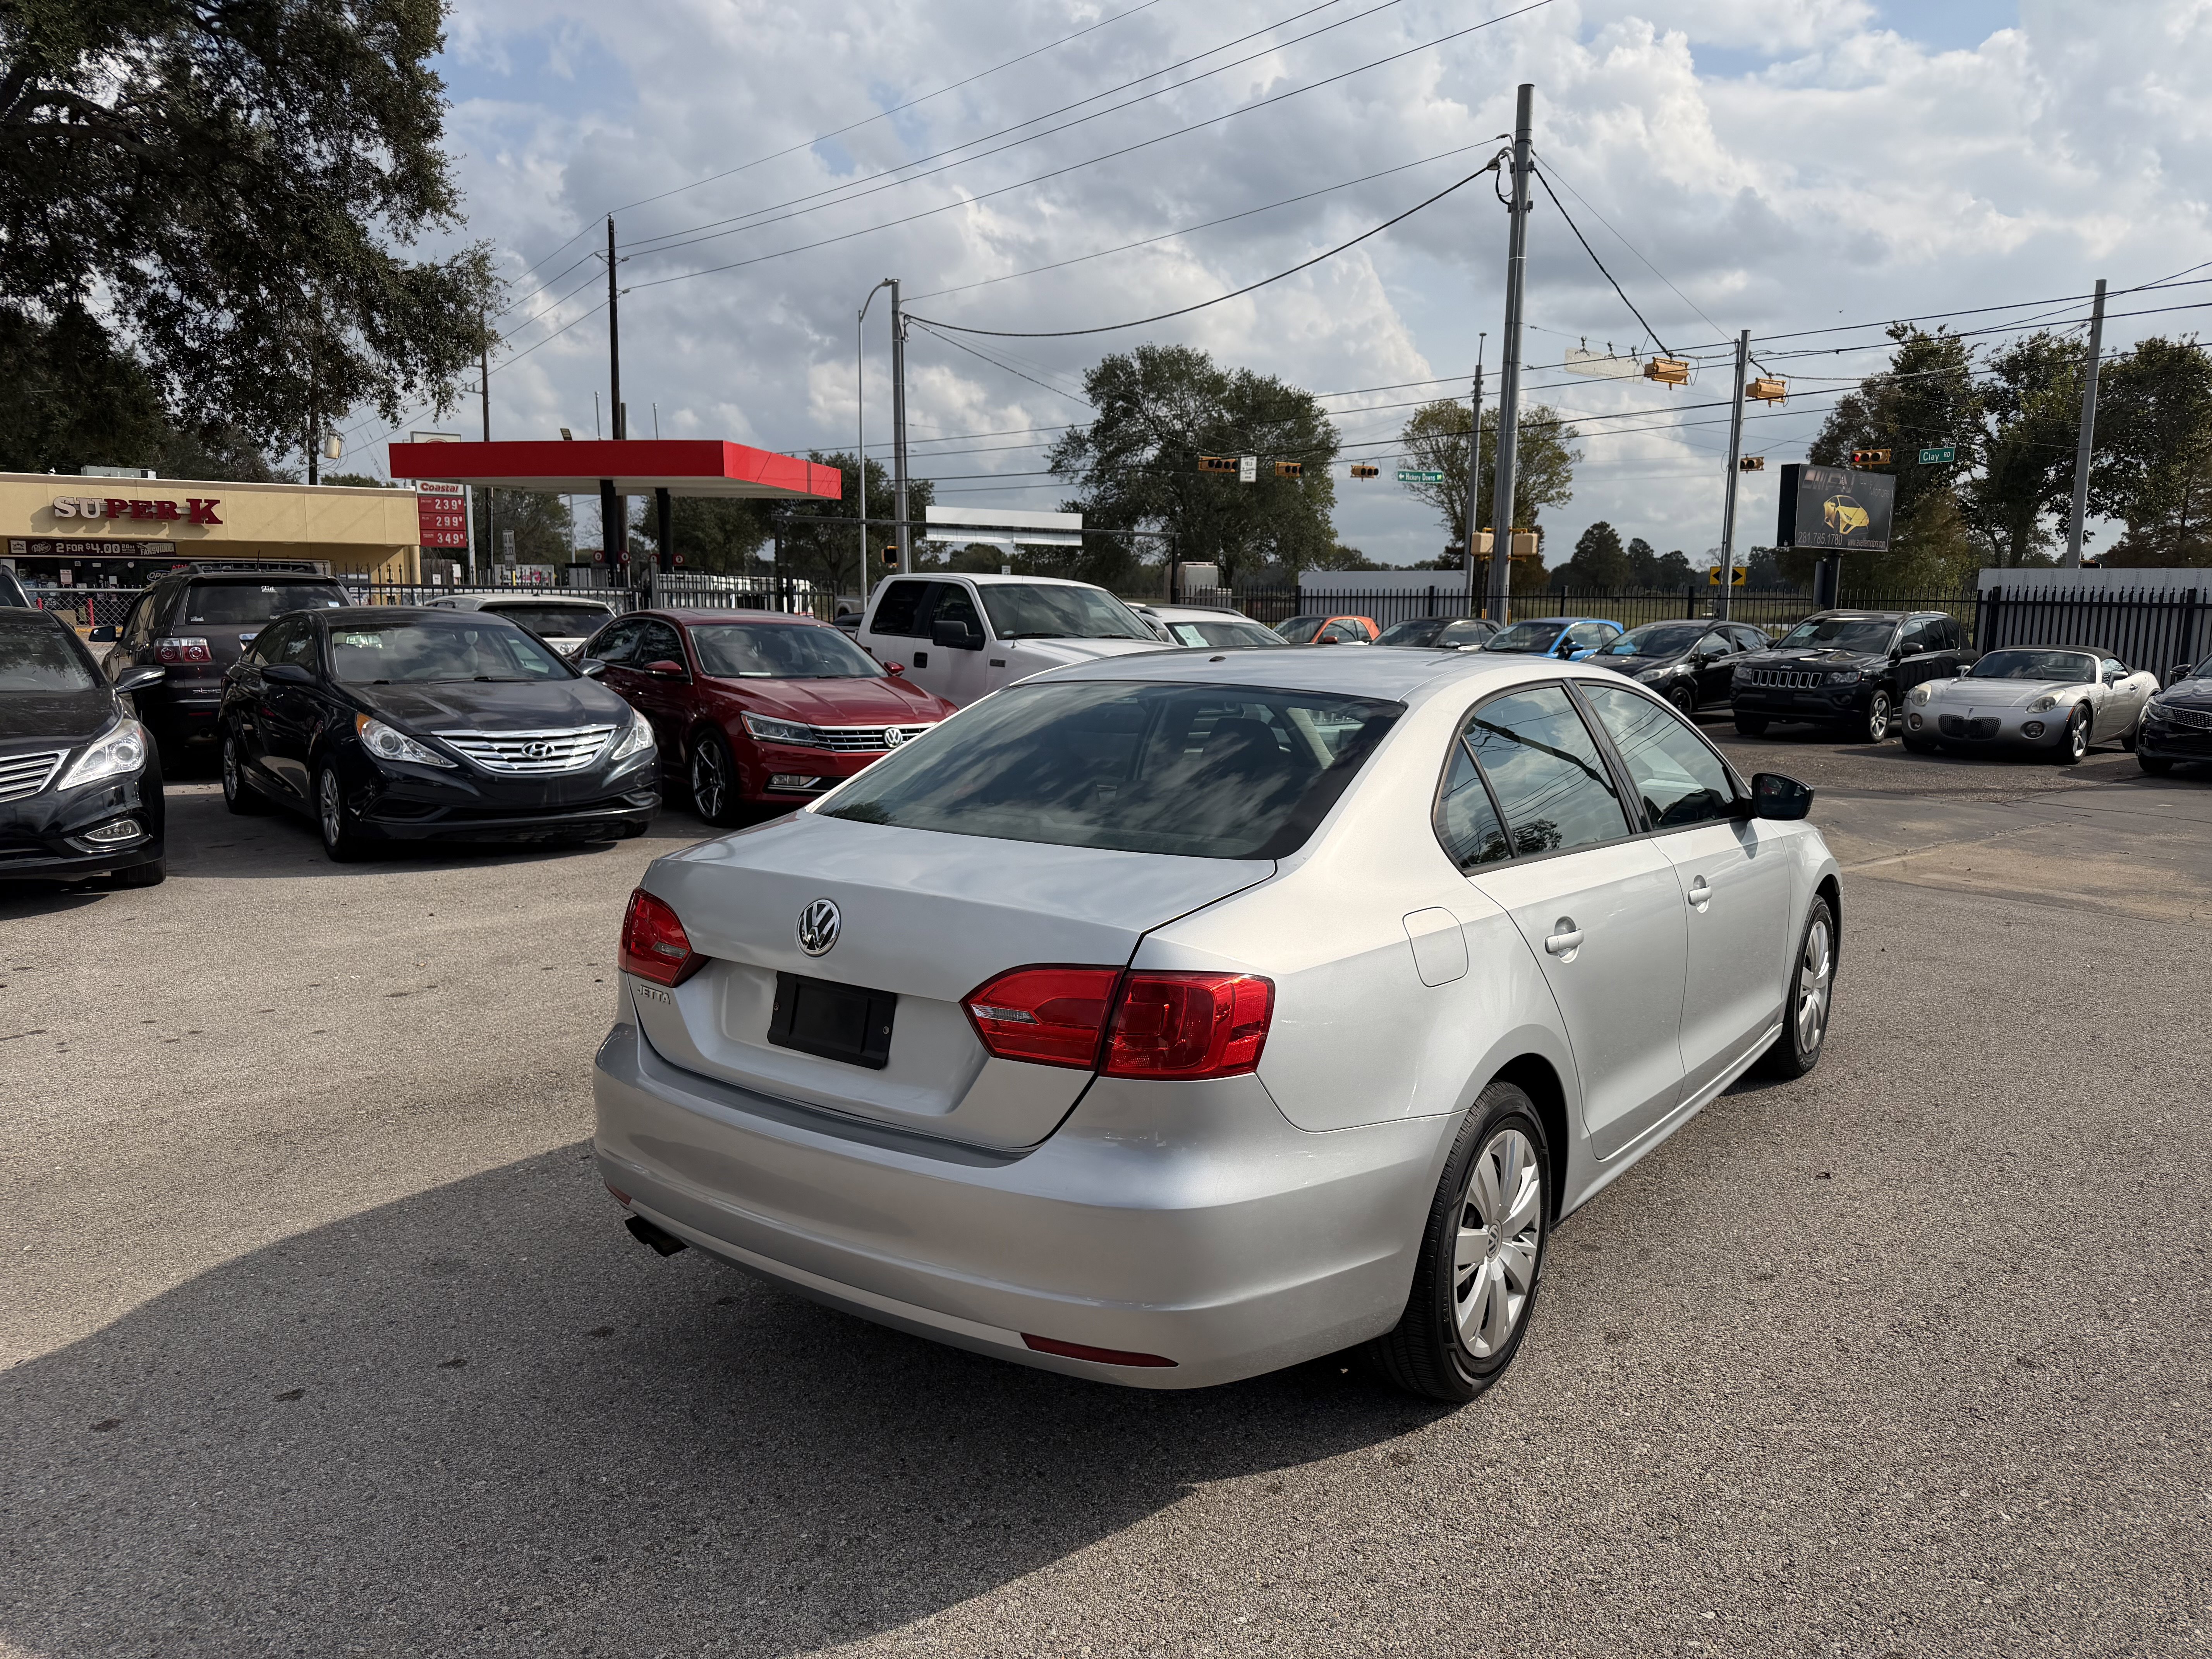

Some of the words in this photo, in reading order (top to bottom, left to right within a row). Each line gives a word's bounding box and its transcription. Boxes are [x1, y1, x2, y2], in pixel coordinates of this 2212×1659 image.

[1923, 452, 1939, 462] Clay
[1405, 473, 1420, 482] Hickory
[420, 482, 459, 493] Coastal
[53, 496, 181, 520] SUPER
[186, 498, 223, 524] K
[1798, 532, 1843, 546] 281.785.1780
[56, 543, 65, 553] 2
[85, 543, 120, 553] $4.00
[637, 984, 670, 1005] JETTA
